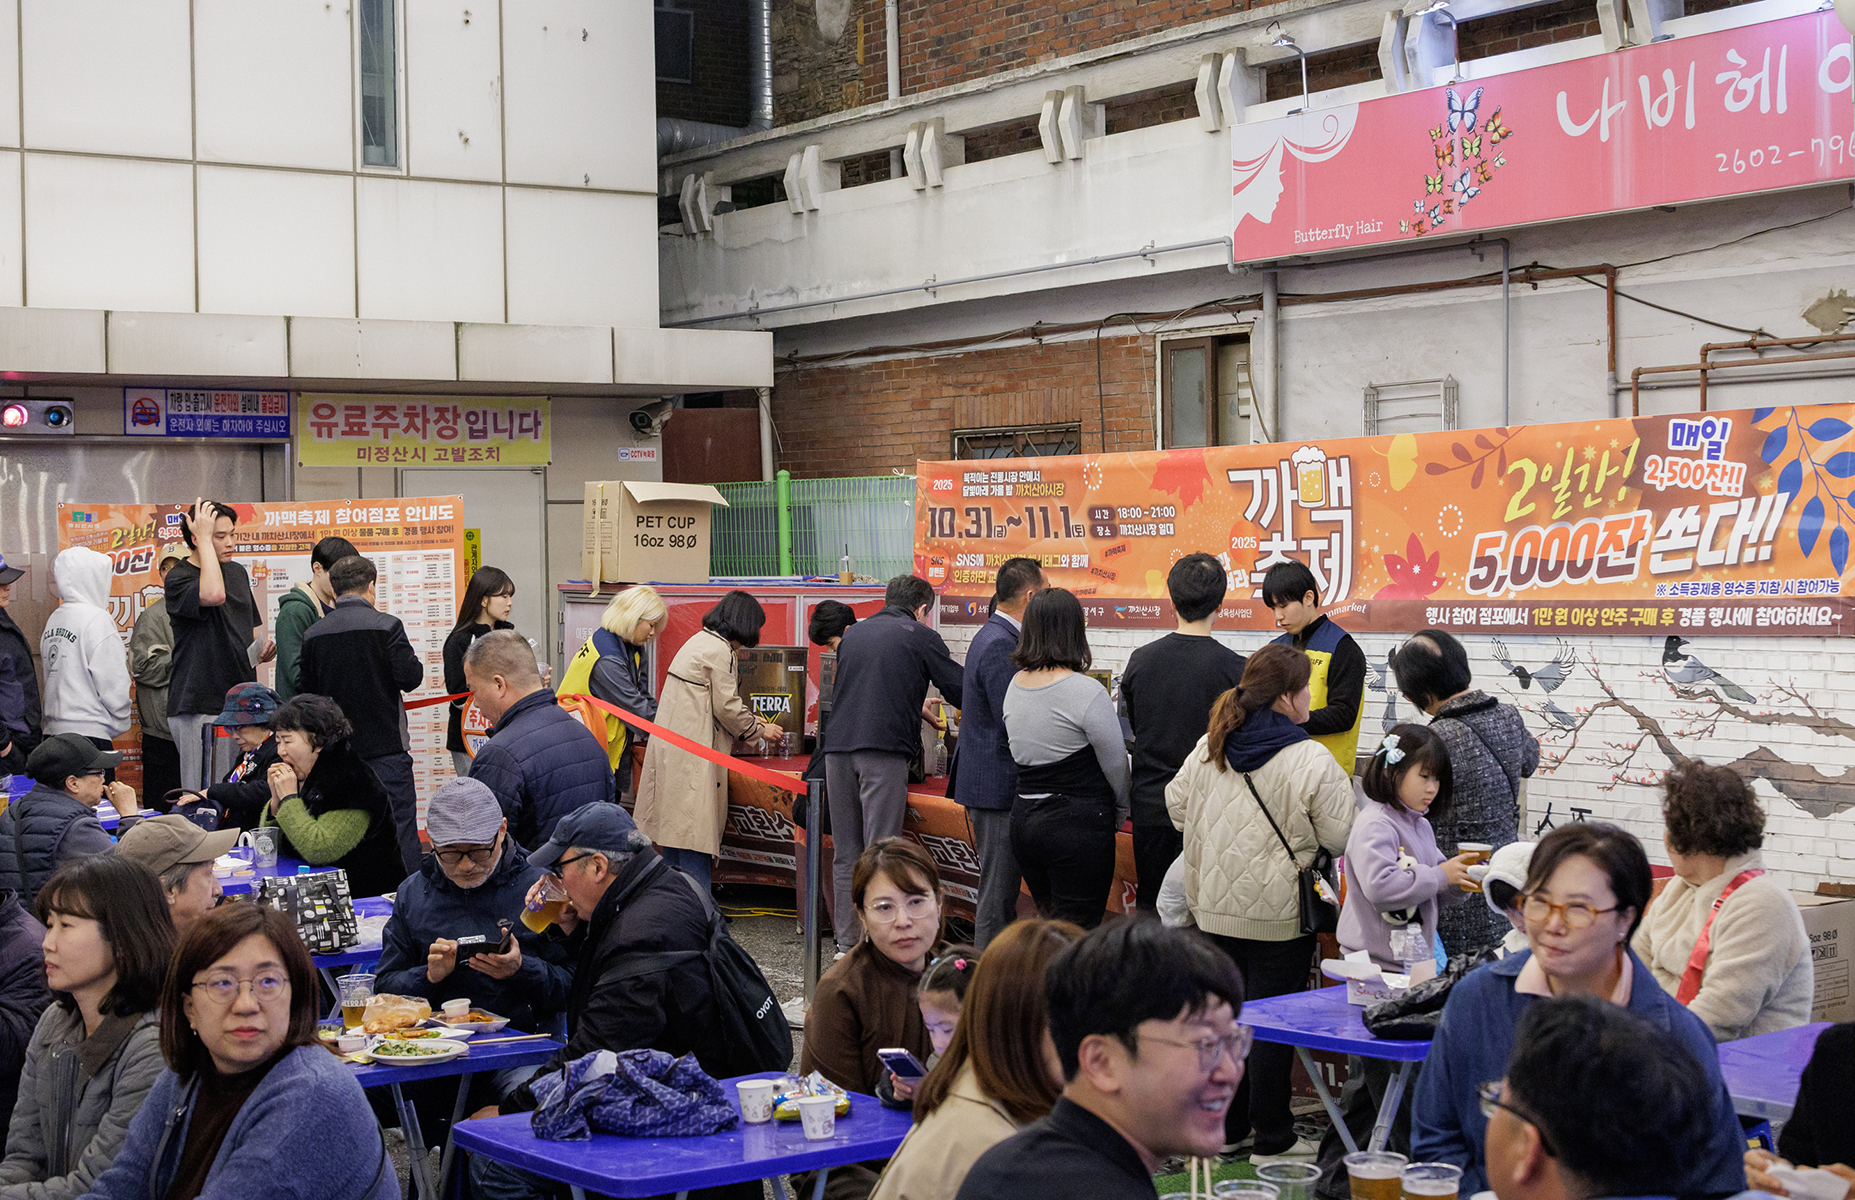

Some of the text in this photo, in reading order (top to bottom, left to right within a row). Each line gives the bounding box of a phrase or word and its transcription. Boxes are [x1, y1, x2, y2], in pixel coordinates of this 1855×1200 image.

[1294, 219, 1384, 244] Butterfly Hair
[170, 393, 184, 412] 차량
[261, 395, 287, 413] 출입금지
[170, 419, 287, 433] 운전자 외에는 하차하여 주십시오
[310, 403, 542, 440] 유료주차장입니다
[1672, 420, 1728, 461] 매일
[433, 446, 501, 462] 고발조치
[963, 470, 1041, 484] 북적이는 전통시장 안에서
[1504, 437, 1641, 523] 2일간!
[1646, 458, 1746, 494] 2,500잔!!
[933, 479, 953, 490] 2025
[962, 482, 1065, 497] 달빛아래 가을 밤 까치산야시장
[264, 505, 454, 527] 까맥축제 참여점포 안내도
[1095, 509, 1109, 519] 시간
[1117, 507, 1142, 519] 18:00
[1150, 506, 1176, 518] 21:00
[636, 516, 696, 529] PET CUP
[1096, 523, 1175, 536] 장소 까치산시장 일대
[111, 519, 156, 548] 2일간!
[236, 532, 250, 541] 기간
[251, 532, 260, 541] 내
[261, 531, 315, 541] 까치산시장에서
[319, 529, 332, 538] 1만
[342, 528, 358, 537] 이상
[375, 528, 390, 536] 구매
[391, 527, 399, 536] 후
[403, 527, 418, 535] 경품
[419, 526, 435, 535] 행사
[436, 525, 454, 534] 참여!
[634, 534, 664, 548] 16oz
[1231, 536, 1257, 549] 2025
[1468, 491, 1791, 593] 5,000잔 쏜다!!
[931, 556, 945, 566] SNS
[956, 554, 984, 567] SNS에
[1071, 554, 1089, 567] 함께
[928, 567, 945, 578] 이벤트
[953, 571, 986, 583] 인증하면
[1669, 582, 1721, 596] 소득공제용
[1724, 582, 1756, 595] 영수증
[1758, 581, 1781, 595] 지참
[1783, 581, 1794, 594] 시
[1796, 579, 1840, 594] 참여가능
[1128, 605, 1161, 616] 까치산시장
[1425, 606, 1843, 627] 행사 참여 점포에서 1만 원 이상 안주 구매 후 경품 행사에 참여하세요~
[55, 627, 77, 643] BRUINS
[750, 696, 791, 713] TERRA
